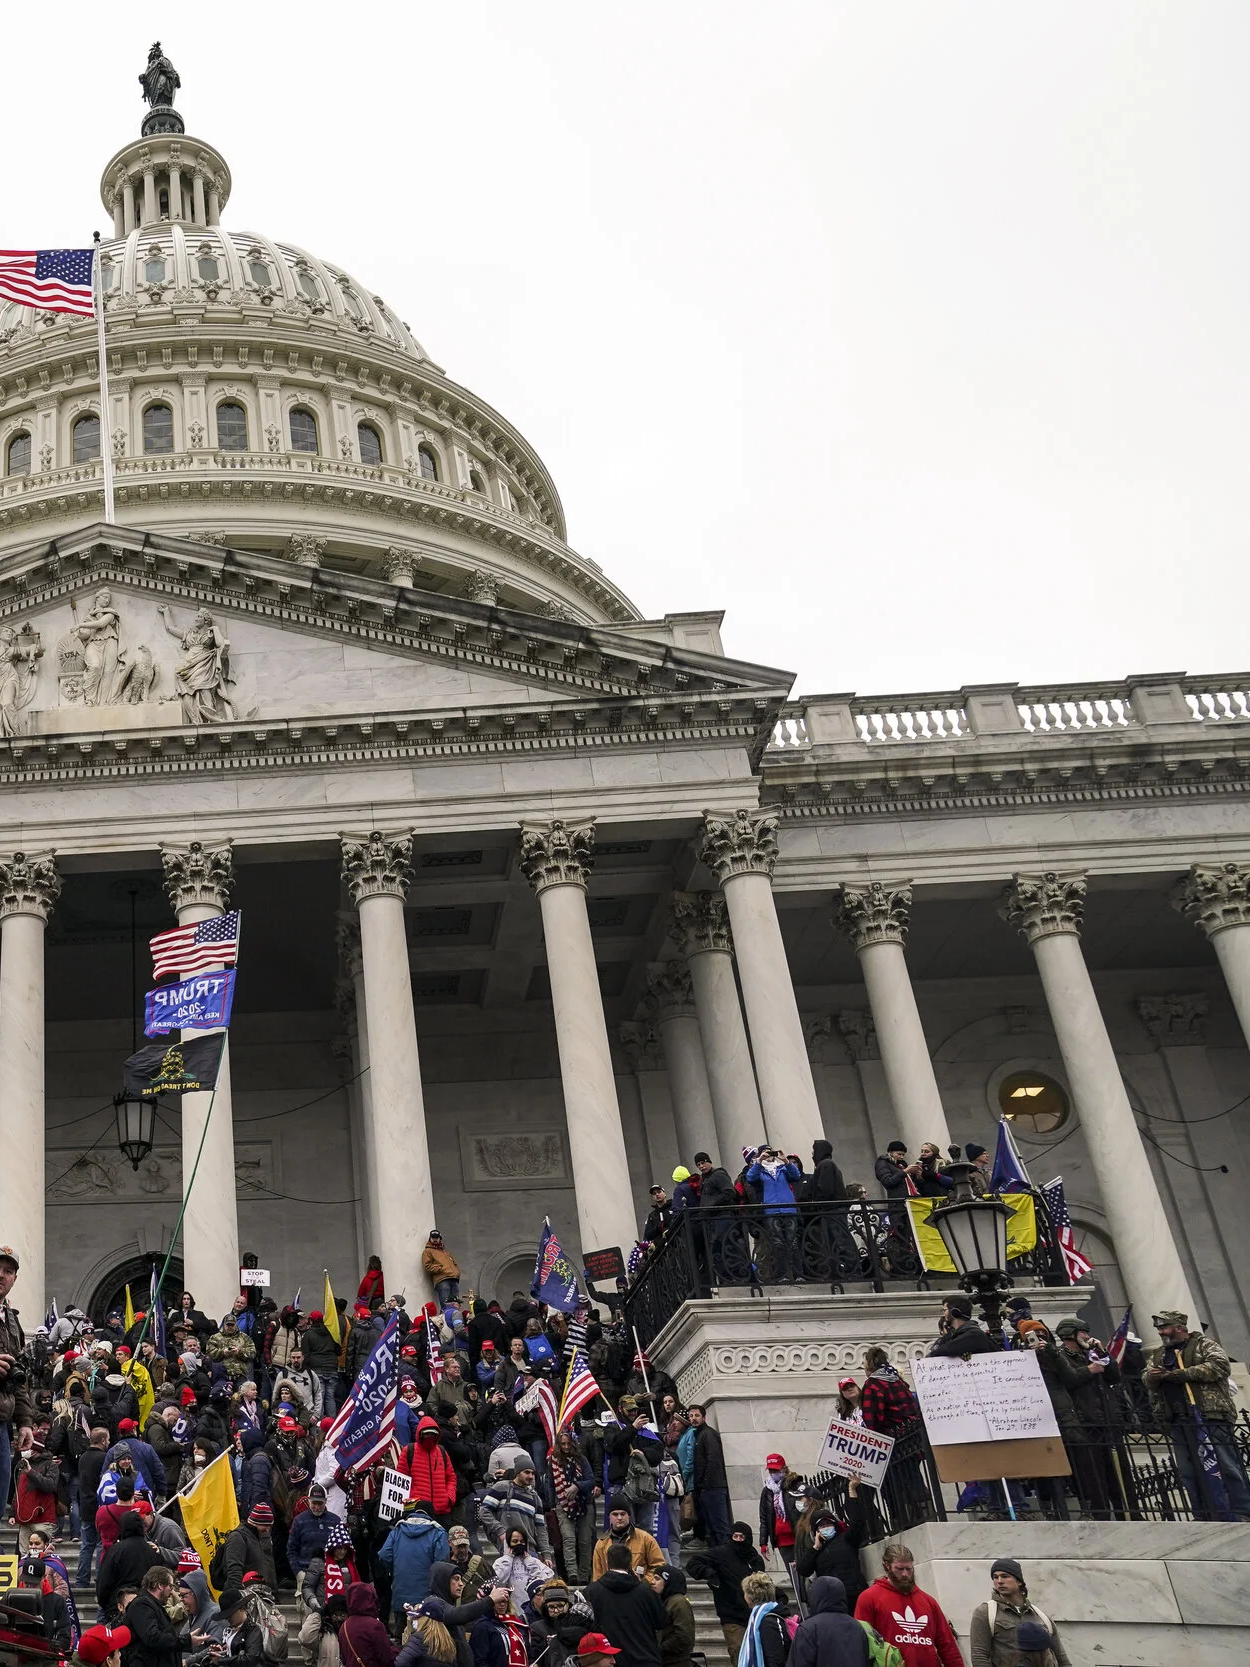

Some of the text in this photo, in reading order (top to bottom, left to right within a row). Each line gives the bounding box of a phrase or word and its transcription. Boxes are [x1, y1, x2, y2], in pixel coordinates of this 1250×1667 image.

[916, 1363, 927, 1375] At
[930, 1361, 946, 1372] what
[948, 1361, 964, 1374] point
[919, 1375, 926, 1384] of
[929, 1374, 950, 1385] danger
[992, 1375, 1003, 1385] It
[830, 1423, 891, 1451] PRESIDENT
[828, 1433, 888, 1465] TRUMP
[843, 1456, 863, 1469] 2020
[384, 1470, 411, 1492] BLACKS
[387, 1488, 404, 1505] FOR
[381, 1503, 403, 1519] TRUM
[27, 1564, 34, 1575] Q
[895, 1633, 933, 1646] adidas
